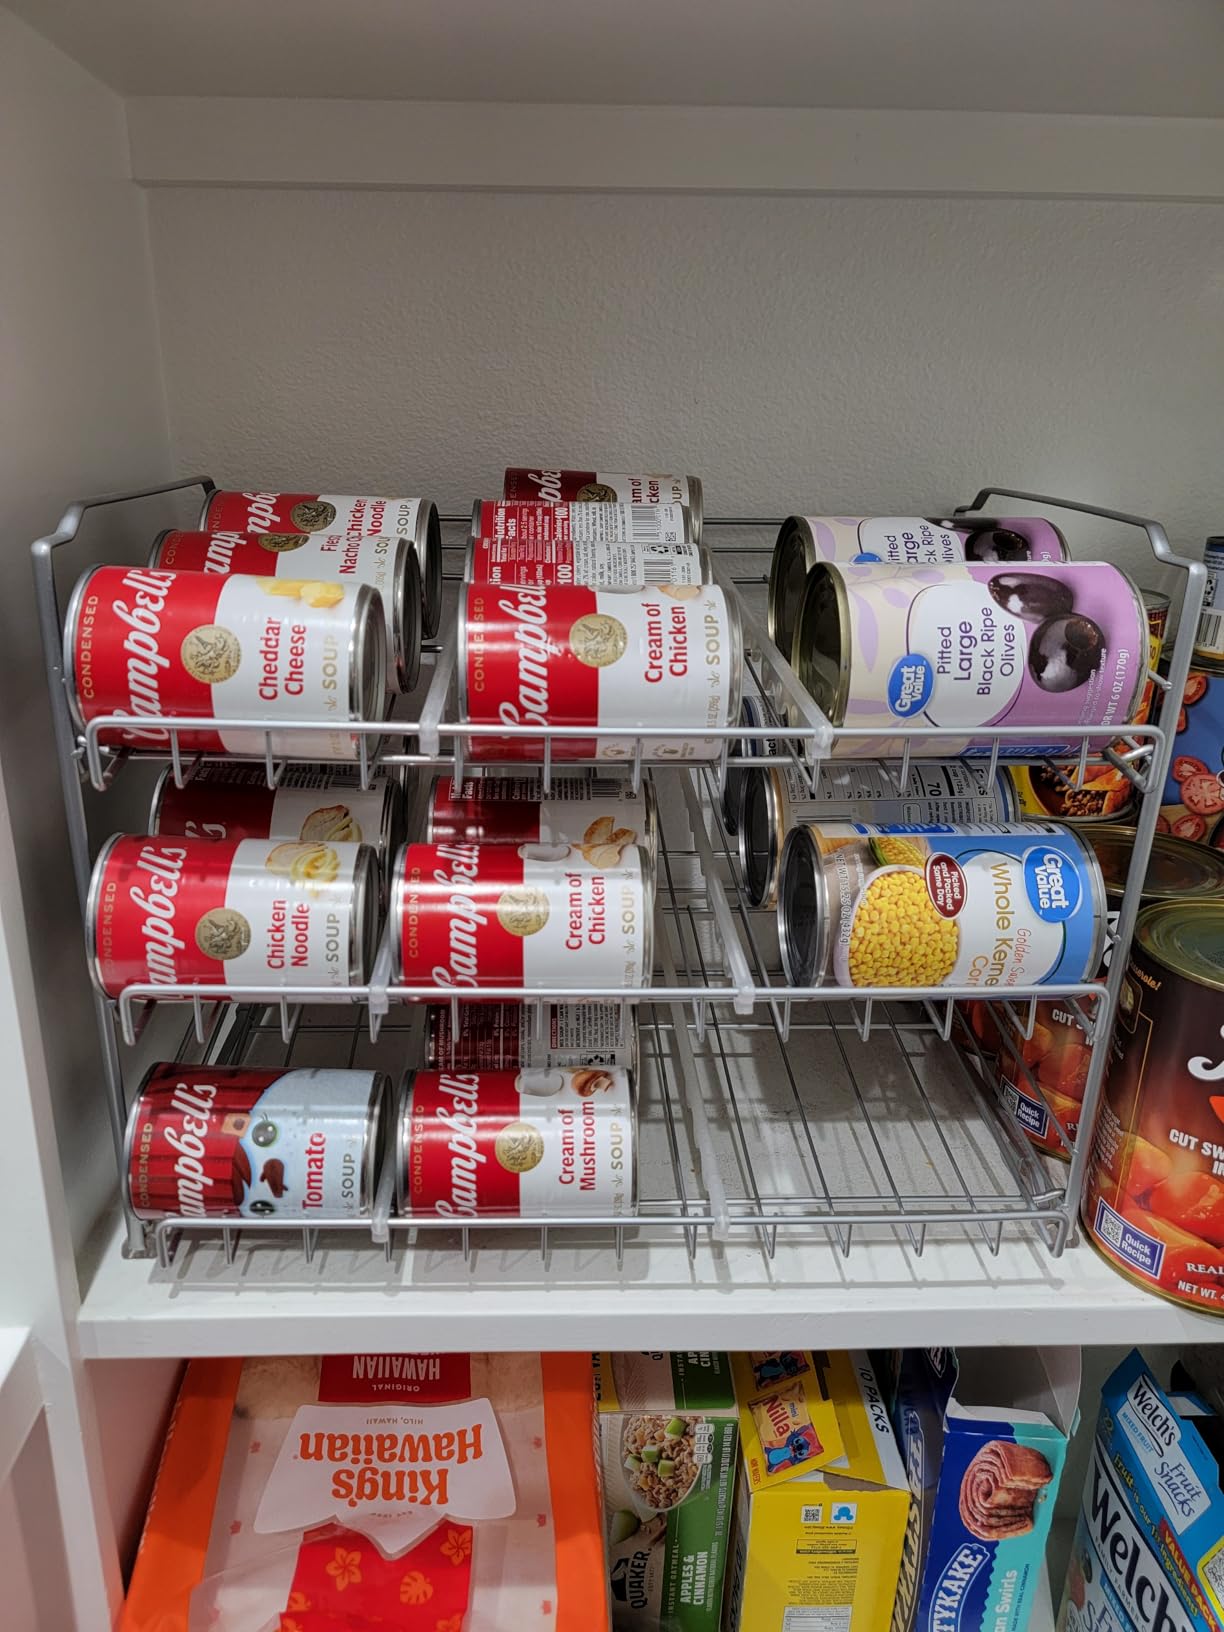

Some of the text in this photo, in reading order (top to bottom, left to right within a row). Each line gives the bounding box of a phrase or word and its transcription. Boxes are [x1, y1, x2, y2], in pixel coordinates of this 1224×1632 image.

[397, 504, 411, 535] SOUP
[555, 507, 568, 518] 100
[919, 525, 935, 546] Ripe
[339, 542, 361, 574] Nacho
[884, 535, 900, 562] itted
[902, 532, 921, 563] arge
[557, 564, 572, 584] 100
[80, 595, 99, 699] CONDENSED
[258, 616, 282, 702] Cheddar
[284, 624, 307, 696] Cheese
[322, 634, 339, 690] SOUP
[641, 602, 663, 684] Cream of
[669, 606, 688, 677] Chicken
[705, 614, 720, 666] SOUP
[936, 626, 953, 674] Pitted
[953, 621, 978, 681] Large
[976, 607, 998, 695] Black Ripe
[1000, 624, 1015, 677] Olives
[911, 665, 926, 701] Value
[1112, 680, 1124, 693] OZ
[1114, 648, 1131, 681] (170g)
[895, 665, 917, 712] Great
[1105, 701, 1118, 715] WT
[766, 738, 776, 756] act
[927, 782, 942, 797] 70
[933, 865, 945, 906] Same Day
[940, 861, 954, 911] and Packed
[950, 871, 962, 900] Picked
[1034, 866, 1051, 909] Value
[1043, 853, 1070, 909] Great
[129, 846, 187, 985] ampbell's
[564, 872, 583, 950] Cream of
[588, 876, 606, 945] Chicken
[621, 888, 635, 935] SOUP
[985, 862, 1015, 986] Whole Kerne
[267, 900, 287, 969] Chicken
[291, 902, 309, 967] Noodle
[325, 913, 339, 962] SOUP
[1016, 928, 1032, 964] Golden
[1052, 1008, 1075, 1026] CUT
[1017, 1108, 1041, 1129] Recipe
[1020, 1102, 1040, 1119] Quick
[164, 1083, 217, 1217] ampbell's
[413, 1105, 425, 1194] CONDENSED
[558, 1108, 575, 1185] Cream of
[580, 1101, 597, 1191] Mushroom
[610, 1122, 623, 1170] SOUP
[1169, 1128, 1199, 1150] CUT
[302, 1133, 327, 1210] Tomato
[342, 1153, 355, 1199] SOUP
[1121, 1240, 1151, 1266] Recipe
[1125, 1233, 1151, 1255] Quick
[1178, 1279, 1218, 1300] NET WT.
[352, 1355, 441, 1381] HAWAIIAN
[371, 1383, 420, 1393] ORIGINAL
[365, 1415, 424, 1425] HILO, HAWAII
[762, 1394, 791, 1437] Nilla
[789, 1402, 799, 1418] mini
[858, 1367, 889, 1434] 10 PACKS
[1133, 1381, 1176, 1447] Welch's
[299, 1423, 483, 1466] Hawaiian
[1121, 1412, 1153, 1454] MIXED FRUIT
[331, 1466, 449, 1508] King's
[1113, 1453, 1134, 1489] Fruit
[1139, 1506, 1152, 1526] our
[1154, 1461, 1195, 1518] Snacks
[1170, 1462, 1202, 1501] Fruit
[1092, 1456, 1188, 1632] Welch
[629, 1551, 649, 1609] QUAKER
[667, 1543, 680, 1614] INSTANT OATMEAL
[680, 1555, 695, 1603] APPLES &
[693, 1551, 708, 1606] CINNAMON
[933, 1548, 983, 1632] TYKAKE
[994, 1569, 1018, 1614] Swirls
[1164, 1529, 1218, 1632] VALUE PACK
